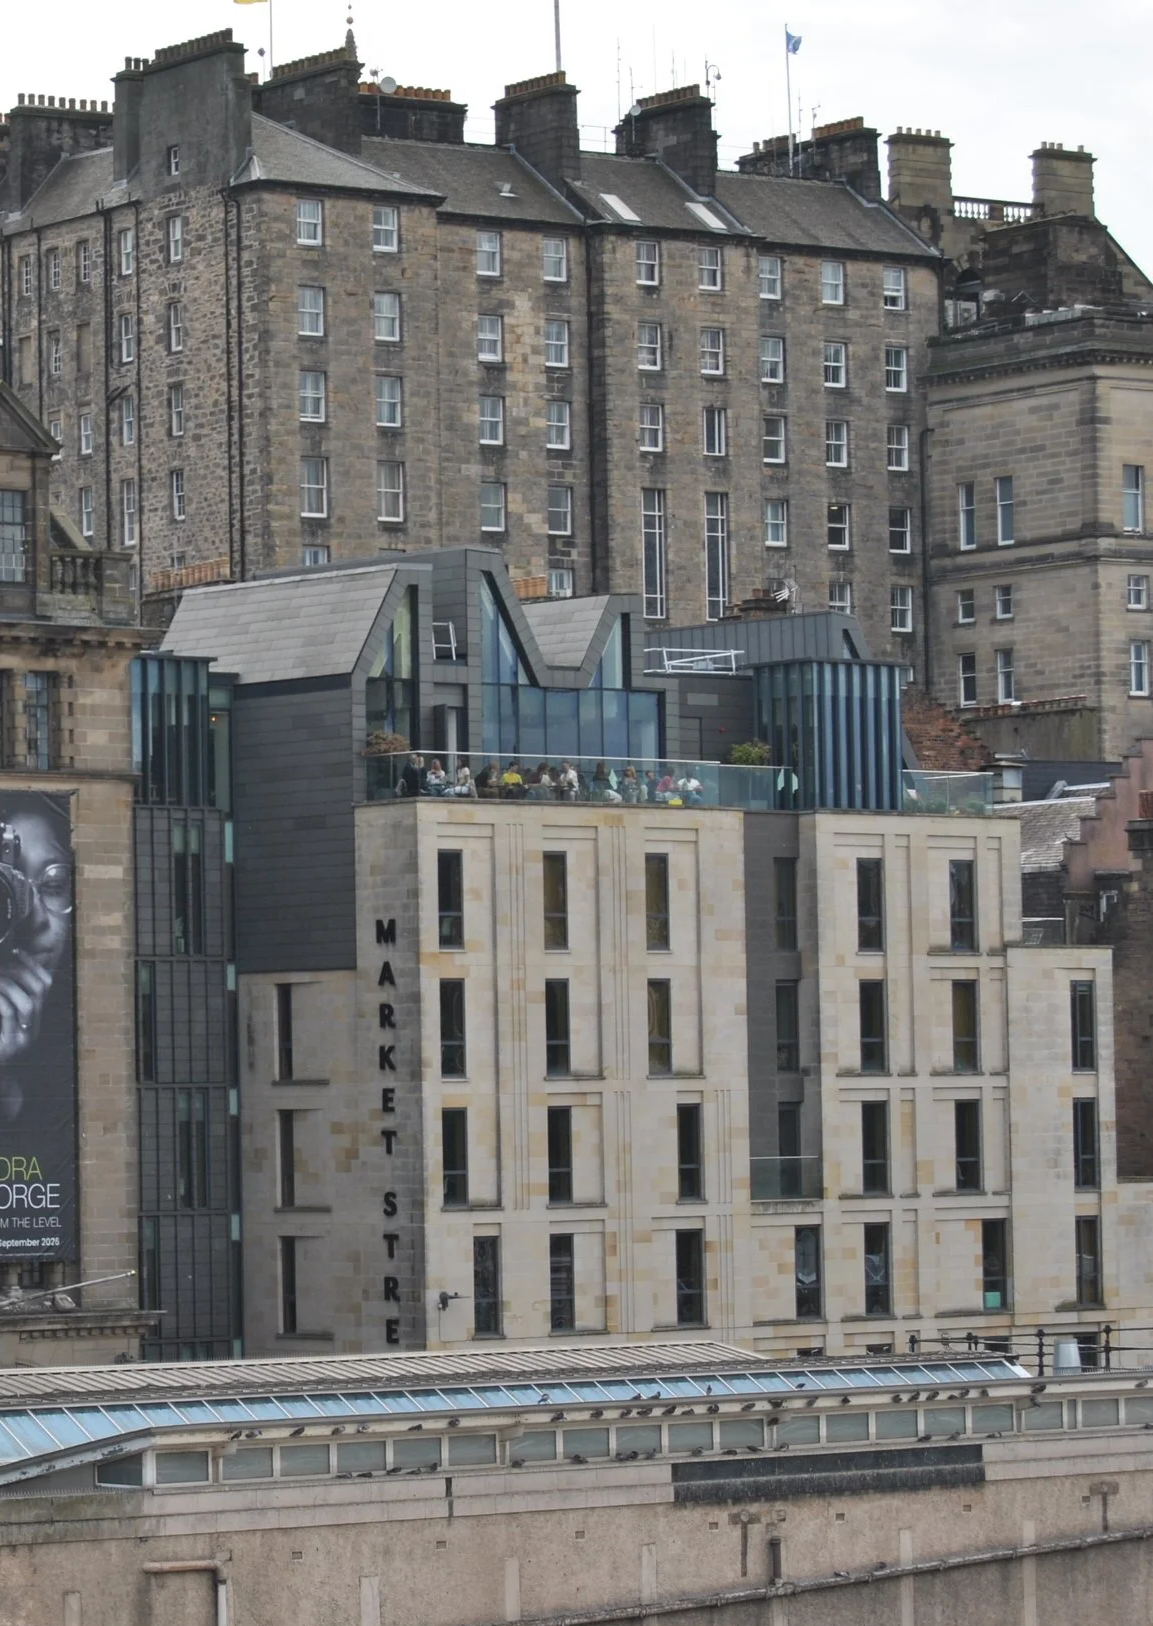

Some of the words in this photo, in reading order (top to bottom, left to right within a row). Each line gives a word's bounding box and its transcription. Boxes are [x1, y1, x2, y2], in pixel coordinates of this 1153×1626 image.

[376, 919, 397, 1155] MARKET
[12, 1216, 31, 1228] THE
[33, 1216, 62, 1228] LEVEL
[383, 1191, 401, 1344] STRE
